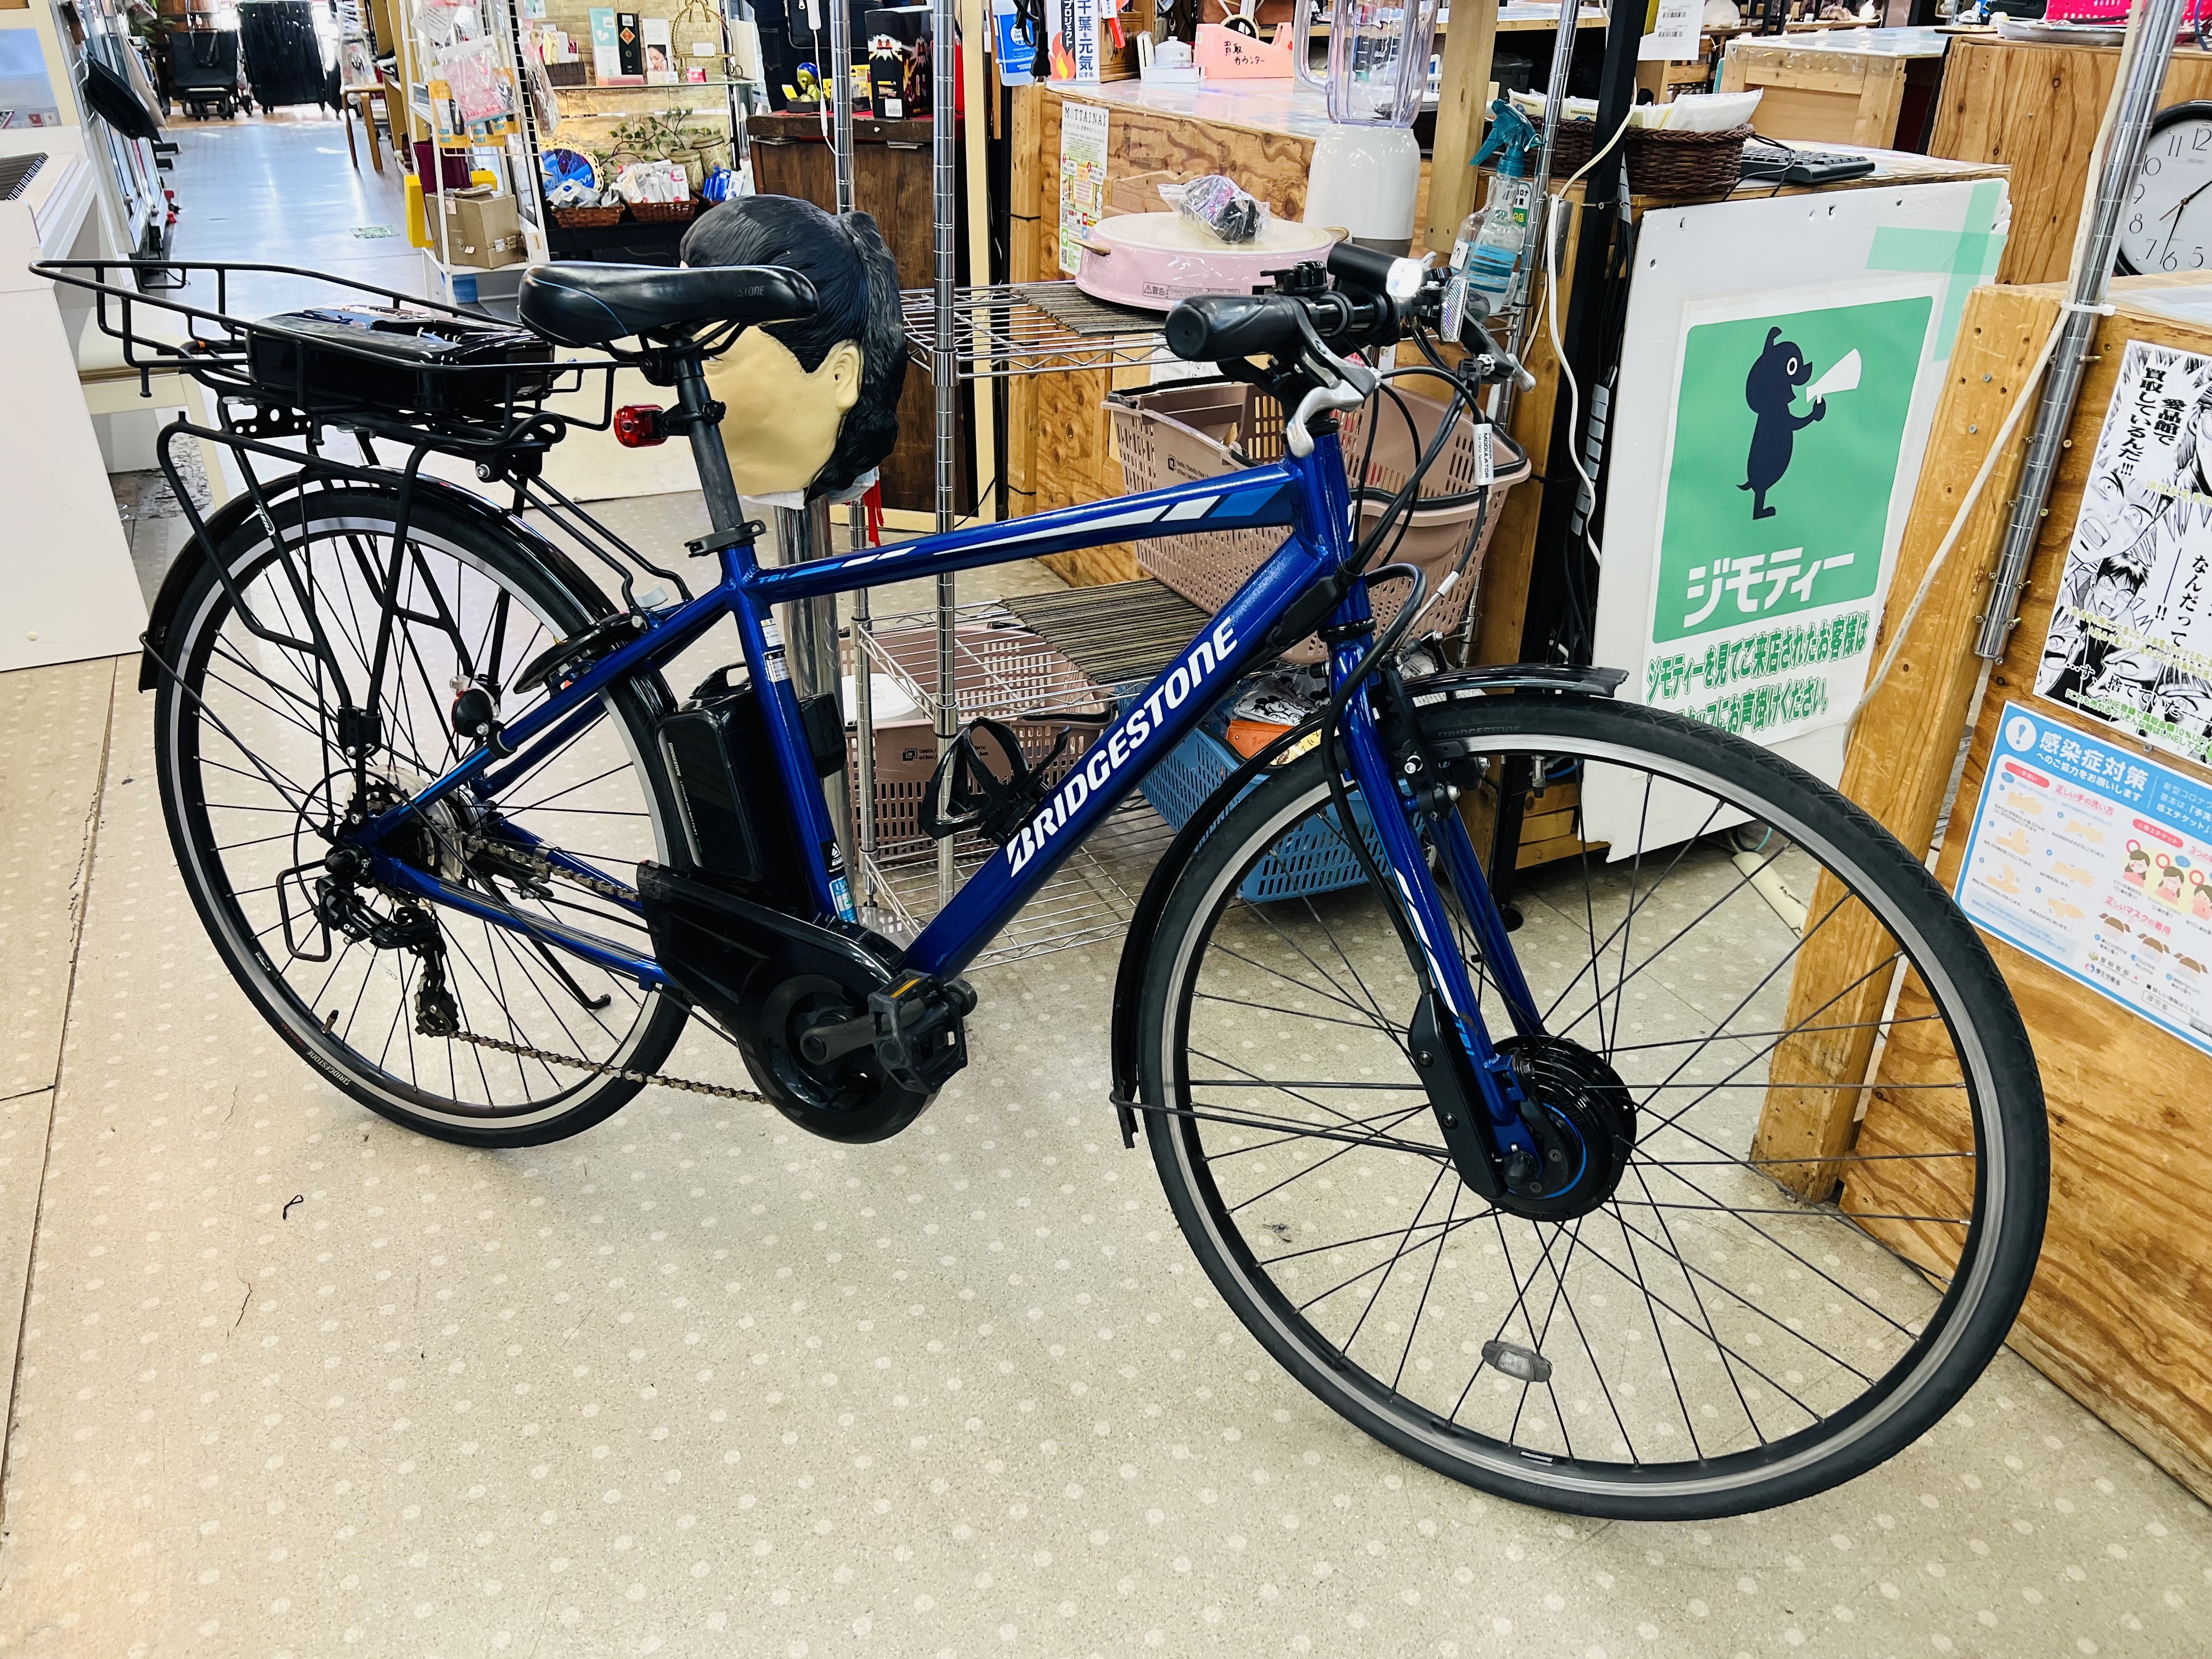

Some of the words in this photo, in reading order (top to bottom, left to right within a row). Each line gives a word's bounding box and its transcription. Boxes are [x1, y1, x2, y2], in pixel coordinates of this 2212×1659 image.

[1077, 0, 1093, 77] 千葉を元気にする
[1224, 41, 1243, 57] 買取
[1234, 56, 1265, 66] カウンター
[2168, 135, 2182, 157] 11
[2192, 128, 2212, 151] 12
[2141, 154, 2162, 176] 10
[2129, 213, 2143, 234] 8
[2146, 238, 2157, 259] 7
[2162, 251, 2177, 272] 6
[2188, 246, 2203, 268] 5
[2153, 397, 2187, 446] 愛品館で
[1683, 546, 1854, 628] ジモティー
[2170, 555, 2209, 647] なんだって
[1647, 610, 1870, 707] ジモティーを見てご来店されたお客様は
[668, 742, 681, 777] BRIDGESTONE
[1006, 616, 1238, 878] BRIDGESTONE
[2039, 731, 2149, 792] 感染症対策
[2036, 752, 2142, 802] へのご協力をお願いします
[2055, 785, 2115, 816] 正しい手の洗い方
[2105, 895, 2171, 936] 正しいマスクの着用
[306, 1049, 352, 1086] BRIDGESTONE
